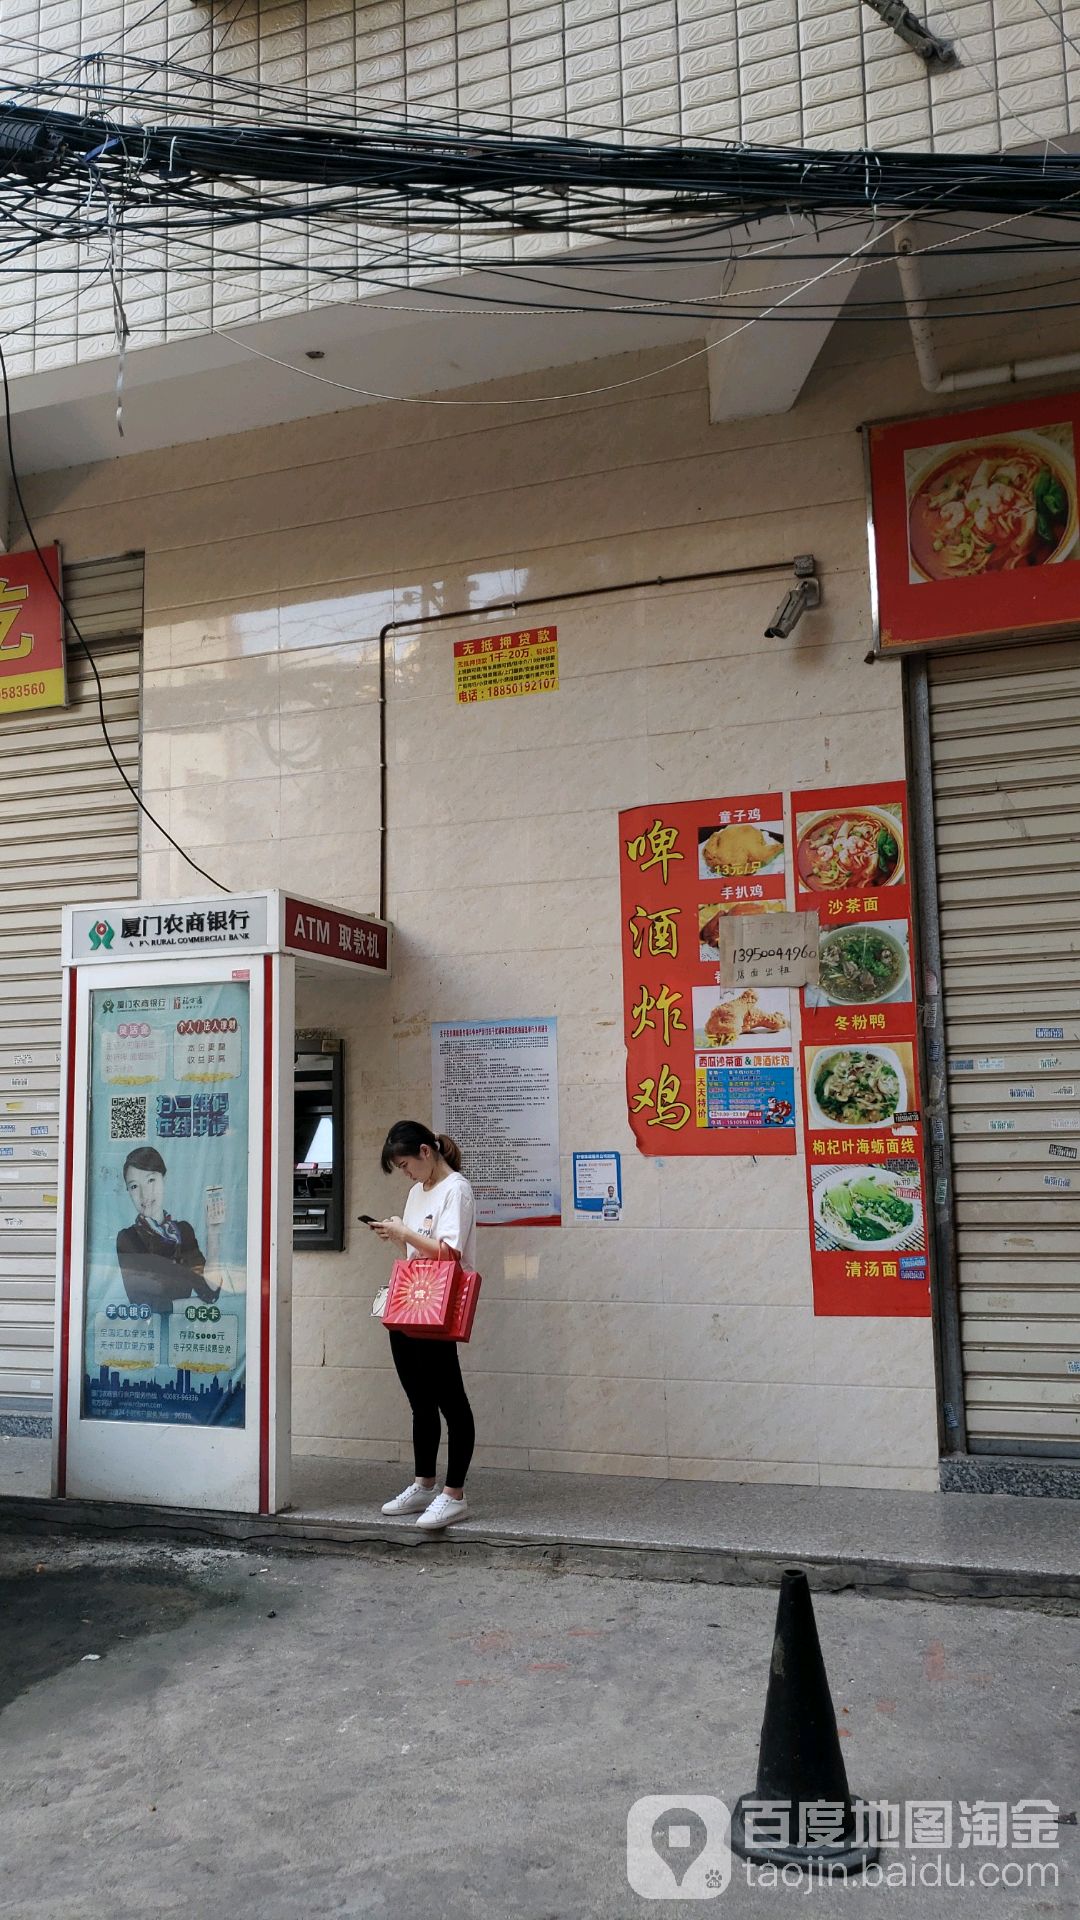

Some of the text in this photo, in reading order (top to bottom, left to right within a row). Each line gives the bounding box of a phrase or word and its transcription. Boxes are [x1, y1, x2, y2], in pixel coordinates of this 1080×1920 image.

[463, 629, 550, 655] 无抵押贷款
[0, 682, 46, 700] 583560
[719, 808, 761, 823] 童子鸡
[714, 861, 761, 876] 13元/只
[721, 884, 763, 898] 手扒鸡
[828, 896, 878, 914] 沙茶面
[121, 910, 250, 938] 厦门农商银行
[151, 938, 177, 947] RURAL
[294, 914, 379, 959] ATM 取款机
[625, 819, 692, 1131] 啤酒炸鸡
[117, 999, 166, 1009] 厦门农商银行
[179, 1019, 236, 1032] 个人/法人理财
[834, 1013, 886, 1030] 冬粉鸭
[699, 1056, 743, 1067] 西瓜沙茶面
[753, 1055, 790, 1066] 啤酒炸鸡
[156, 1093, 229, 1116] 扫二维码
[697, 1077, 706, 1119] 天天特价
[156, 1115, 230, 1138] 在线申请
[812, 1138, 915, 1155] 枸杞叶海蛎面线
[845, 1260, 897, 1278] 清汤面
[107, 1306, 150, 1318] 手机银行
[187, 1308, 219, 1319] 借记卡
[179, 1331, 225, 1341] 存款5000元
